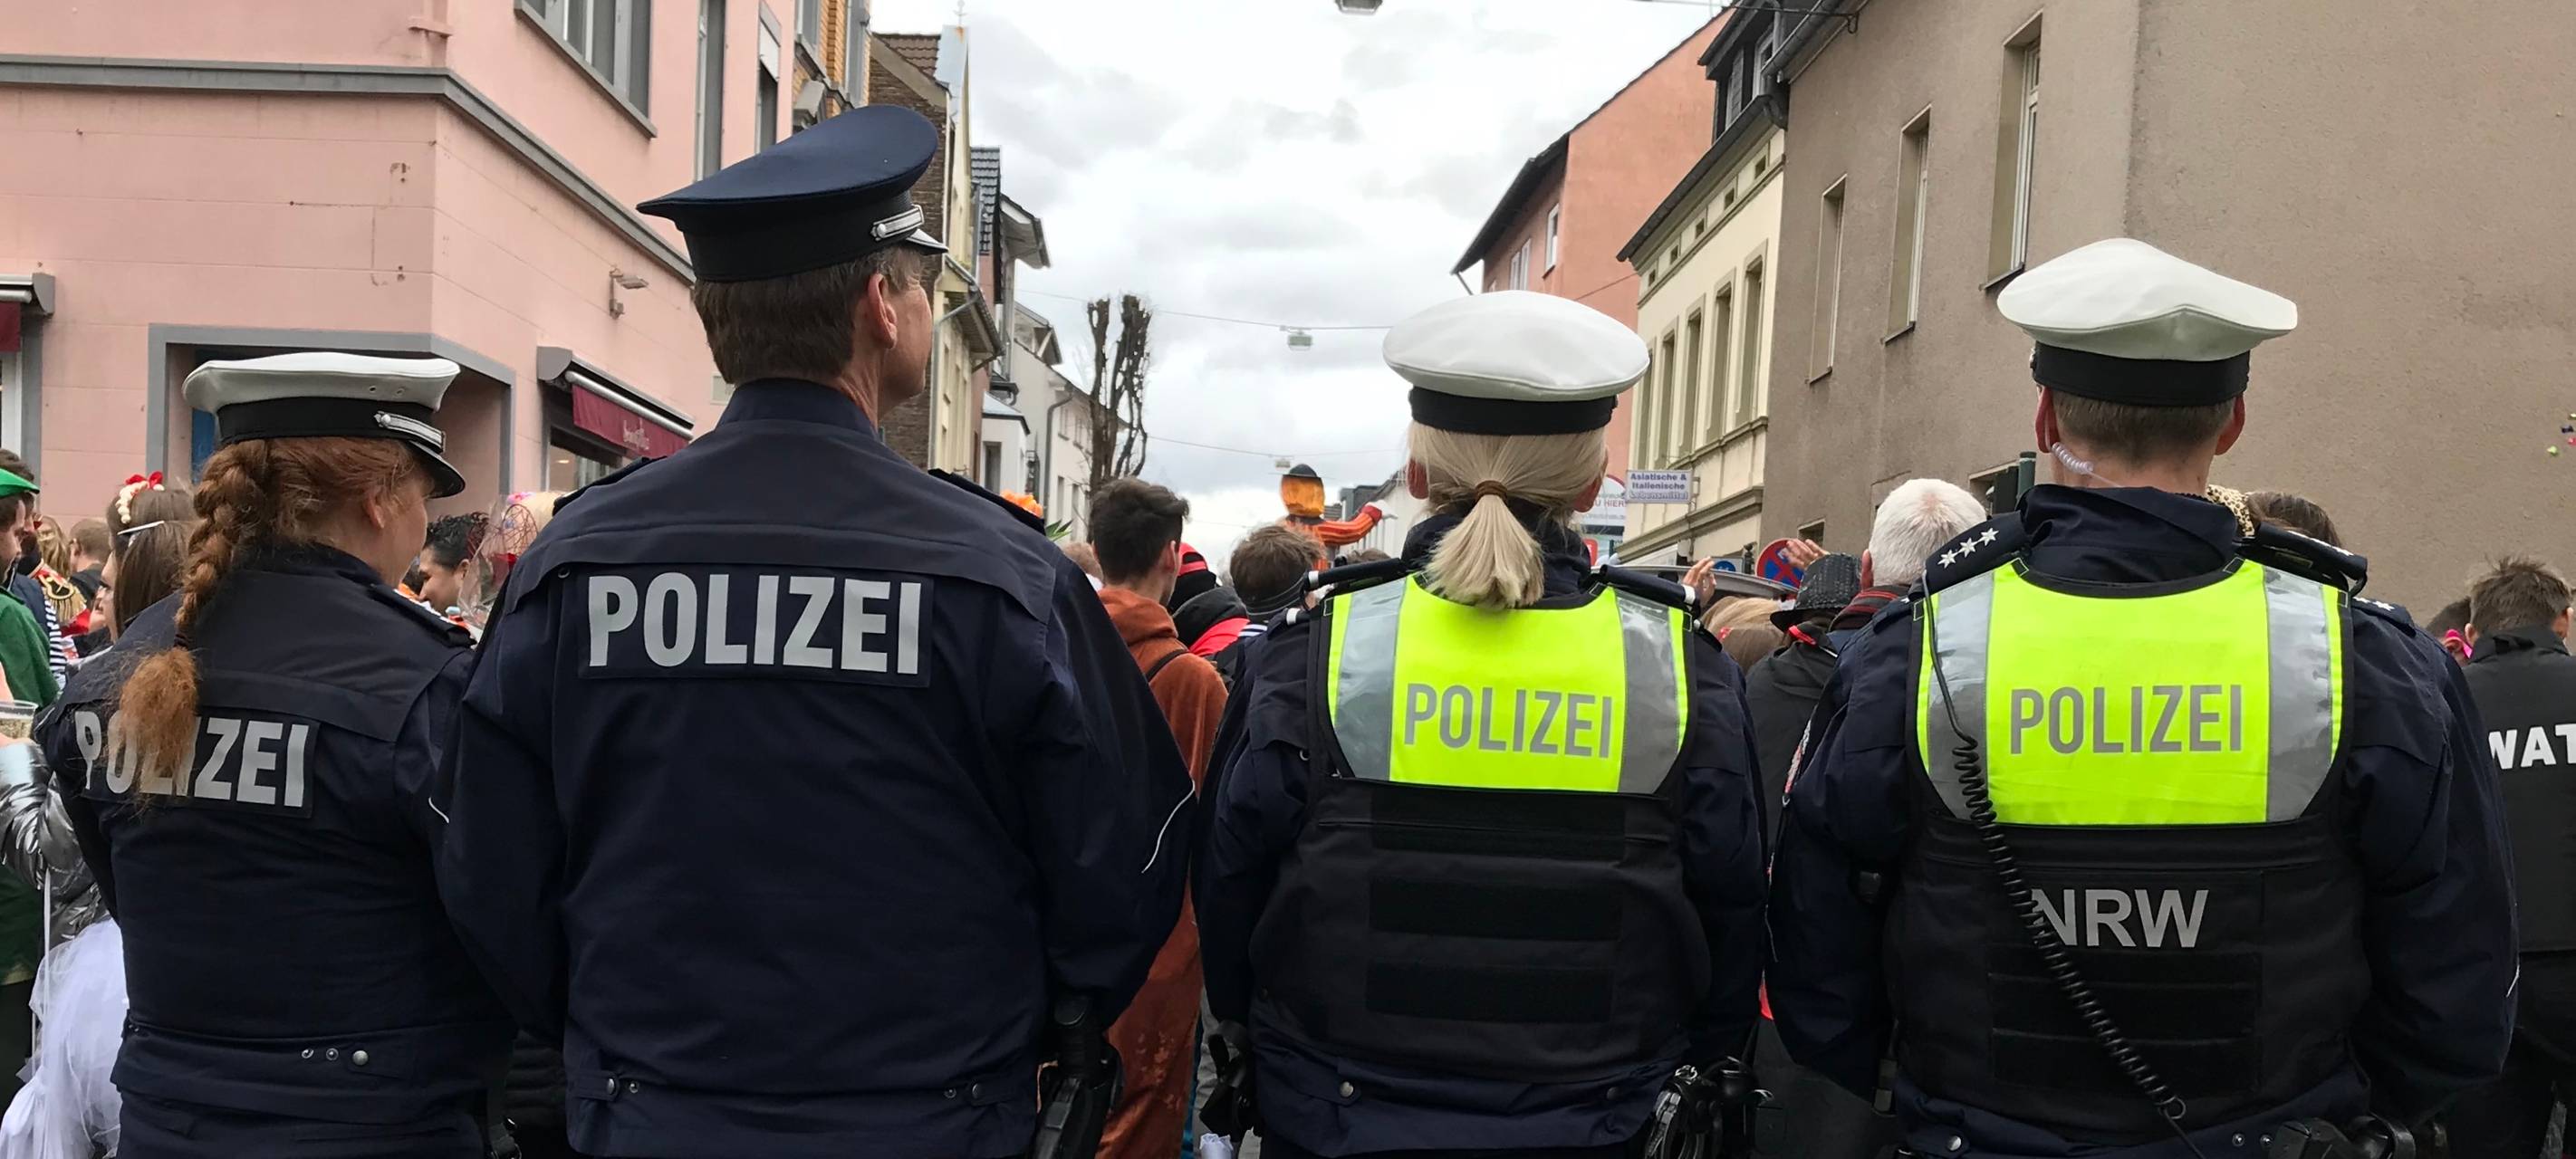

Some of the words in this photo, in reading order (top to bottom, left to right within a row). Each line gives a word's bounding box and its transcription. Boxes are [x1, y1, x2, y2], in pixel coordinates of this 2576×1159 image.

[1630, 473, 1677, 481] Asiatische
[1680, 473, 1687, 481] &
[1631, 482, 1686, 490] Italienische
[588, 571, 922, 675] POLIZEI
[1404, 683, 1612, 759] POLIZEI
[2010, 684, 2242, 755] POLIZEI
[2031, 888, 2209, 948] NRW
